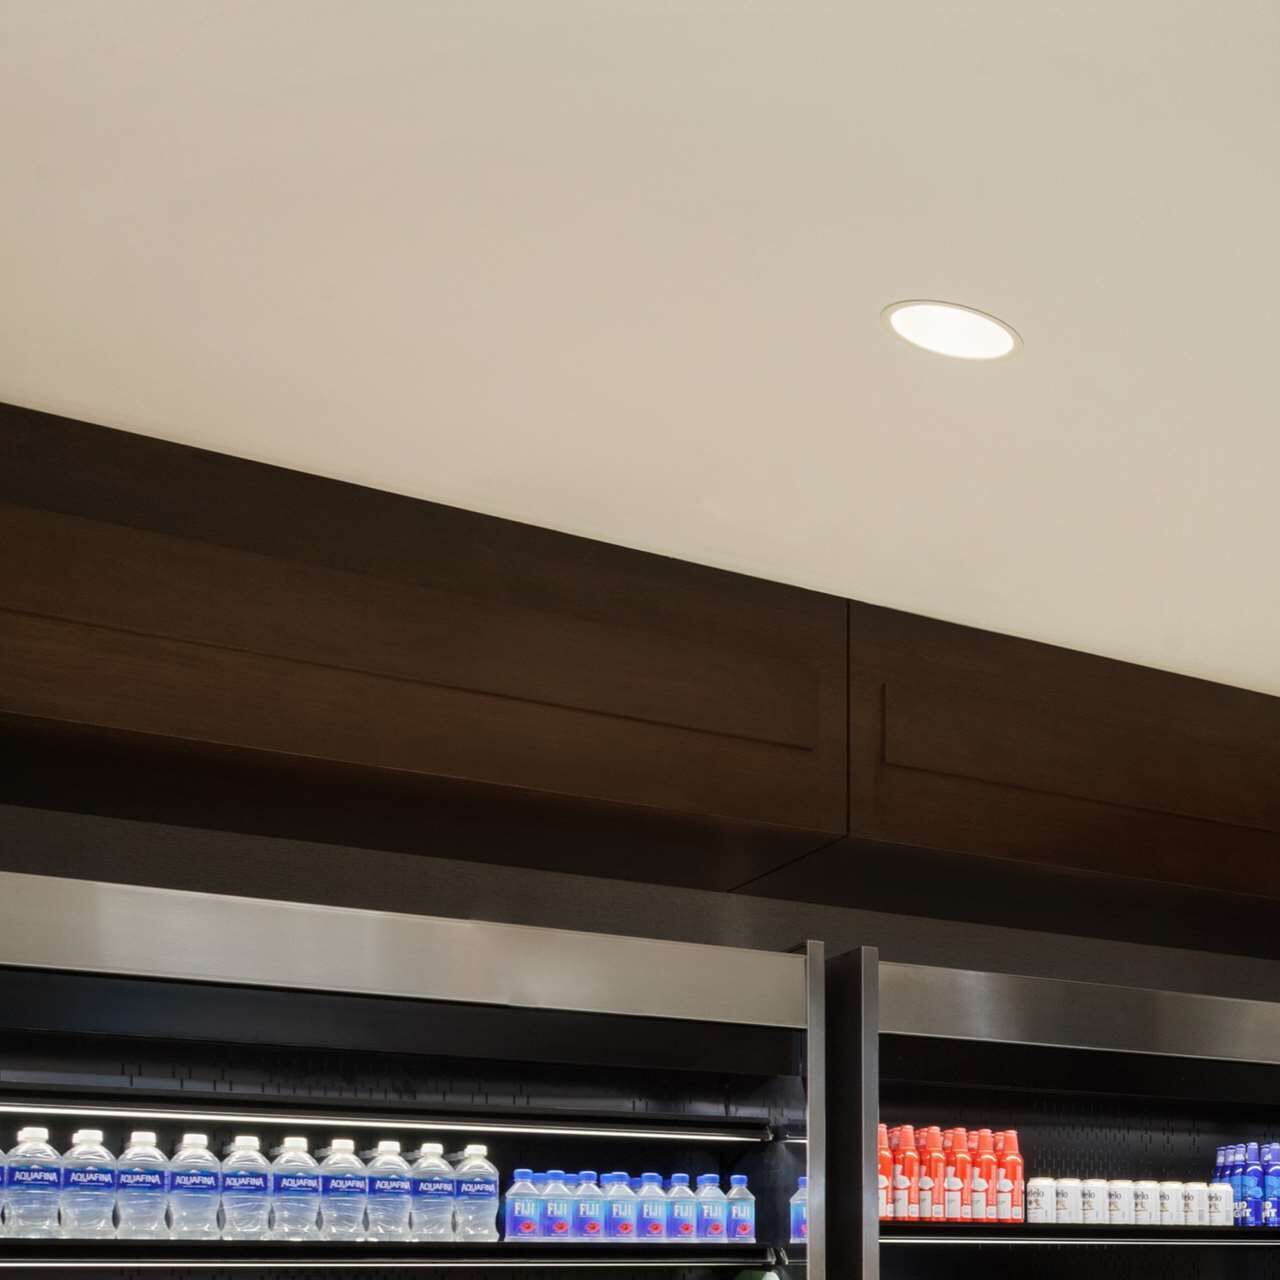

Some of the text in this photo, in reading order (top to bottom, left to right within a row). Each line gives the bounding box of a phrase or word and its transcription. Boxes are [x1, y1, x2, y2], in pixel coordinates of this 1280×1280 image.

[120, 1174, 160, 1185] AQUAFINA
[176, 1175, 215, 1187] AQUAFINA
[225, 1176, 264, 1188] AQUAFINA
[281, 1177, 318, 1189] AQUAFINA
[330, 1178, 365, 1189] AQUAFINA
[375, 1179, 411, 1190] AQUAFINA
[613, 1203, 633, 1217] FIJI
[643, 1203, 662, 1217] FIJI
[674, 1203, 694, 1217] FIJI
[703, 1203, 723, 1217] FIJI
[732, 1204, 751, 1217] FIJI
